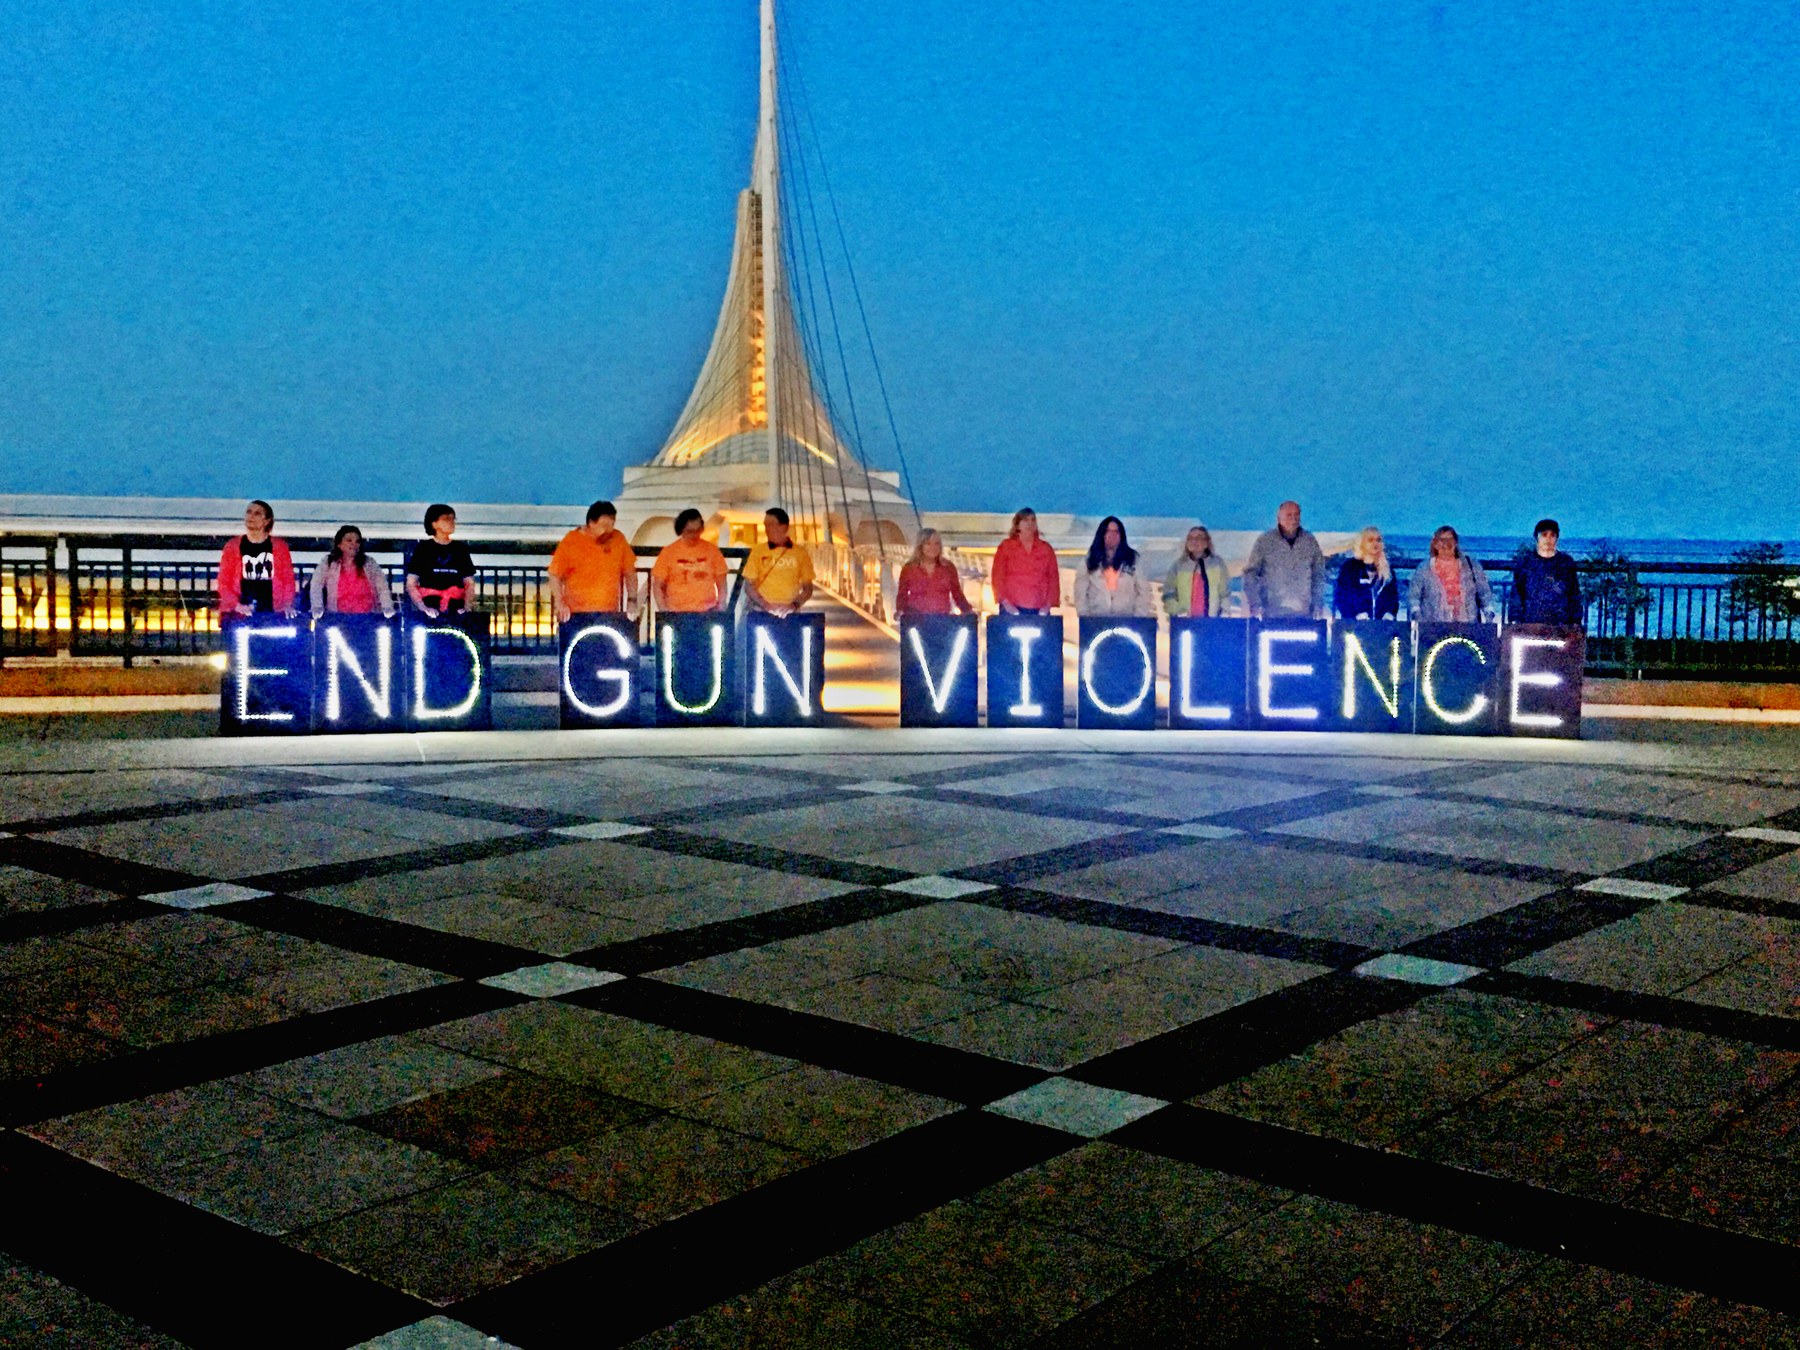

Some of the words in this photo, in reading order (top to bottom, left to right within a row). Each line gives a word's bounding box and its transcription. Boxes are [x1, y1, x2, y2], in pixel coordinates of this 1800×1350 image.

[235, 626, 481, 721] END
[563, 624, 812, 718] GUN
[908, 626, 1566, 727] VIOLENCE
